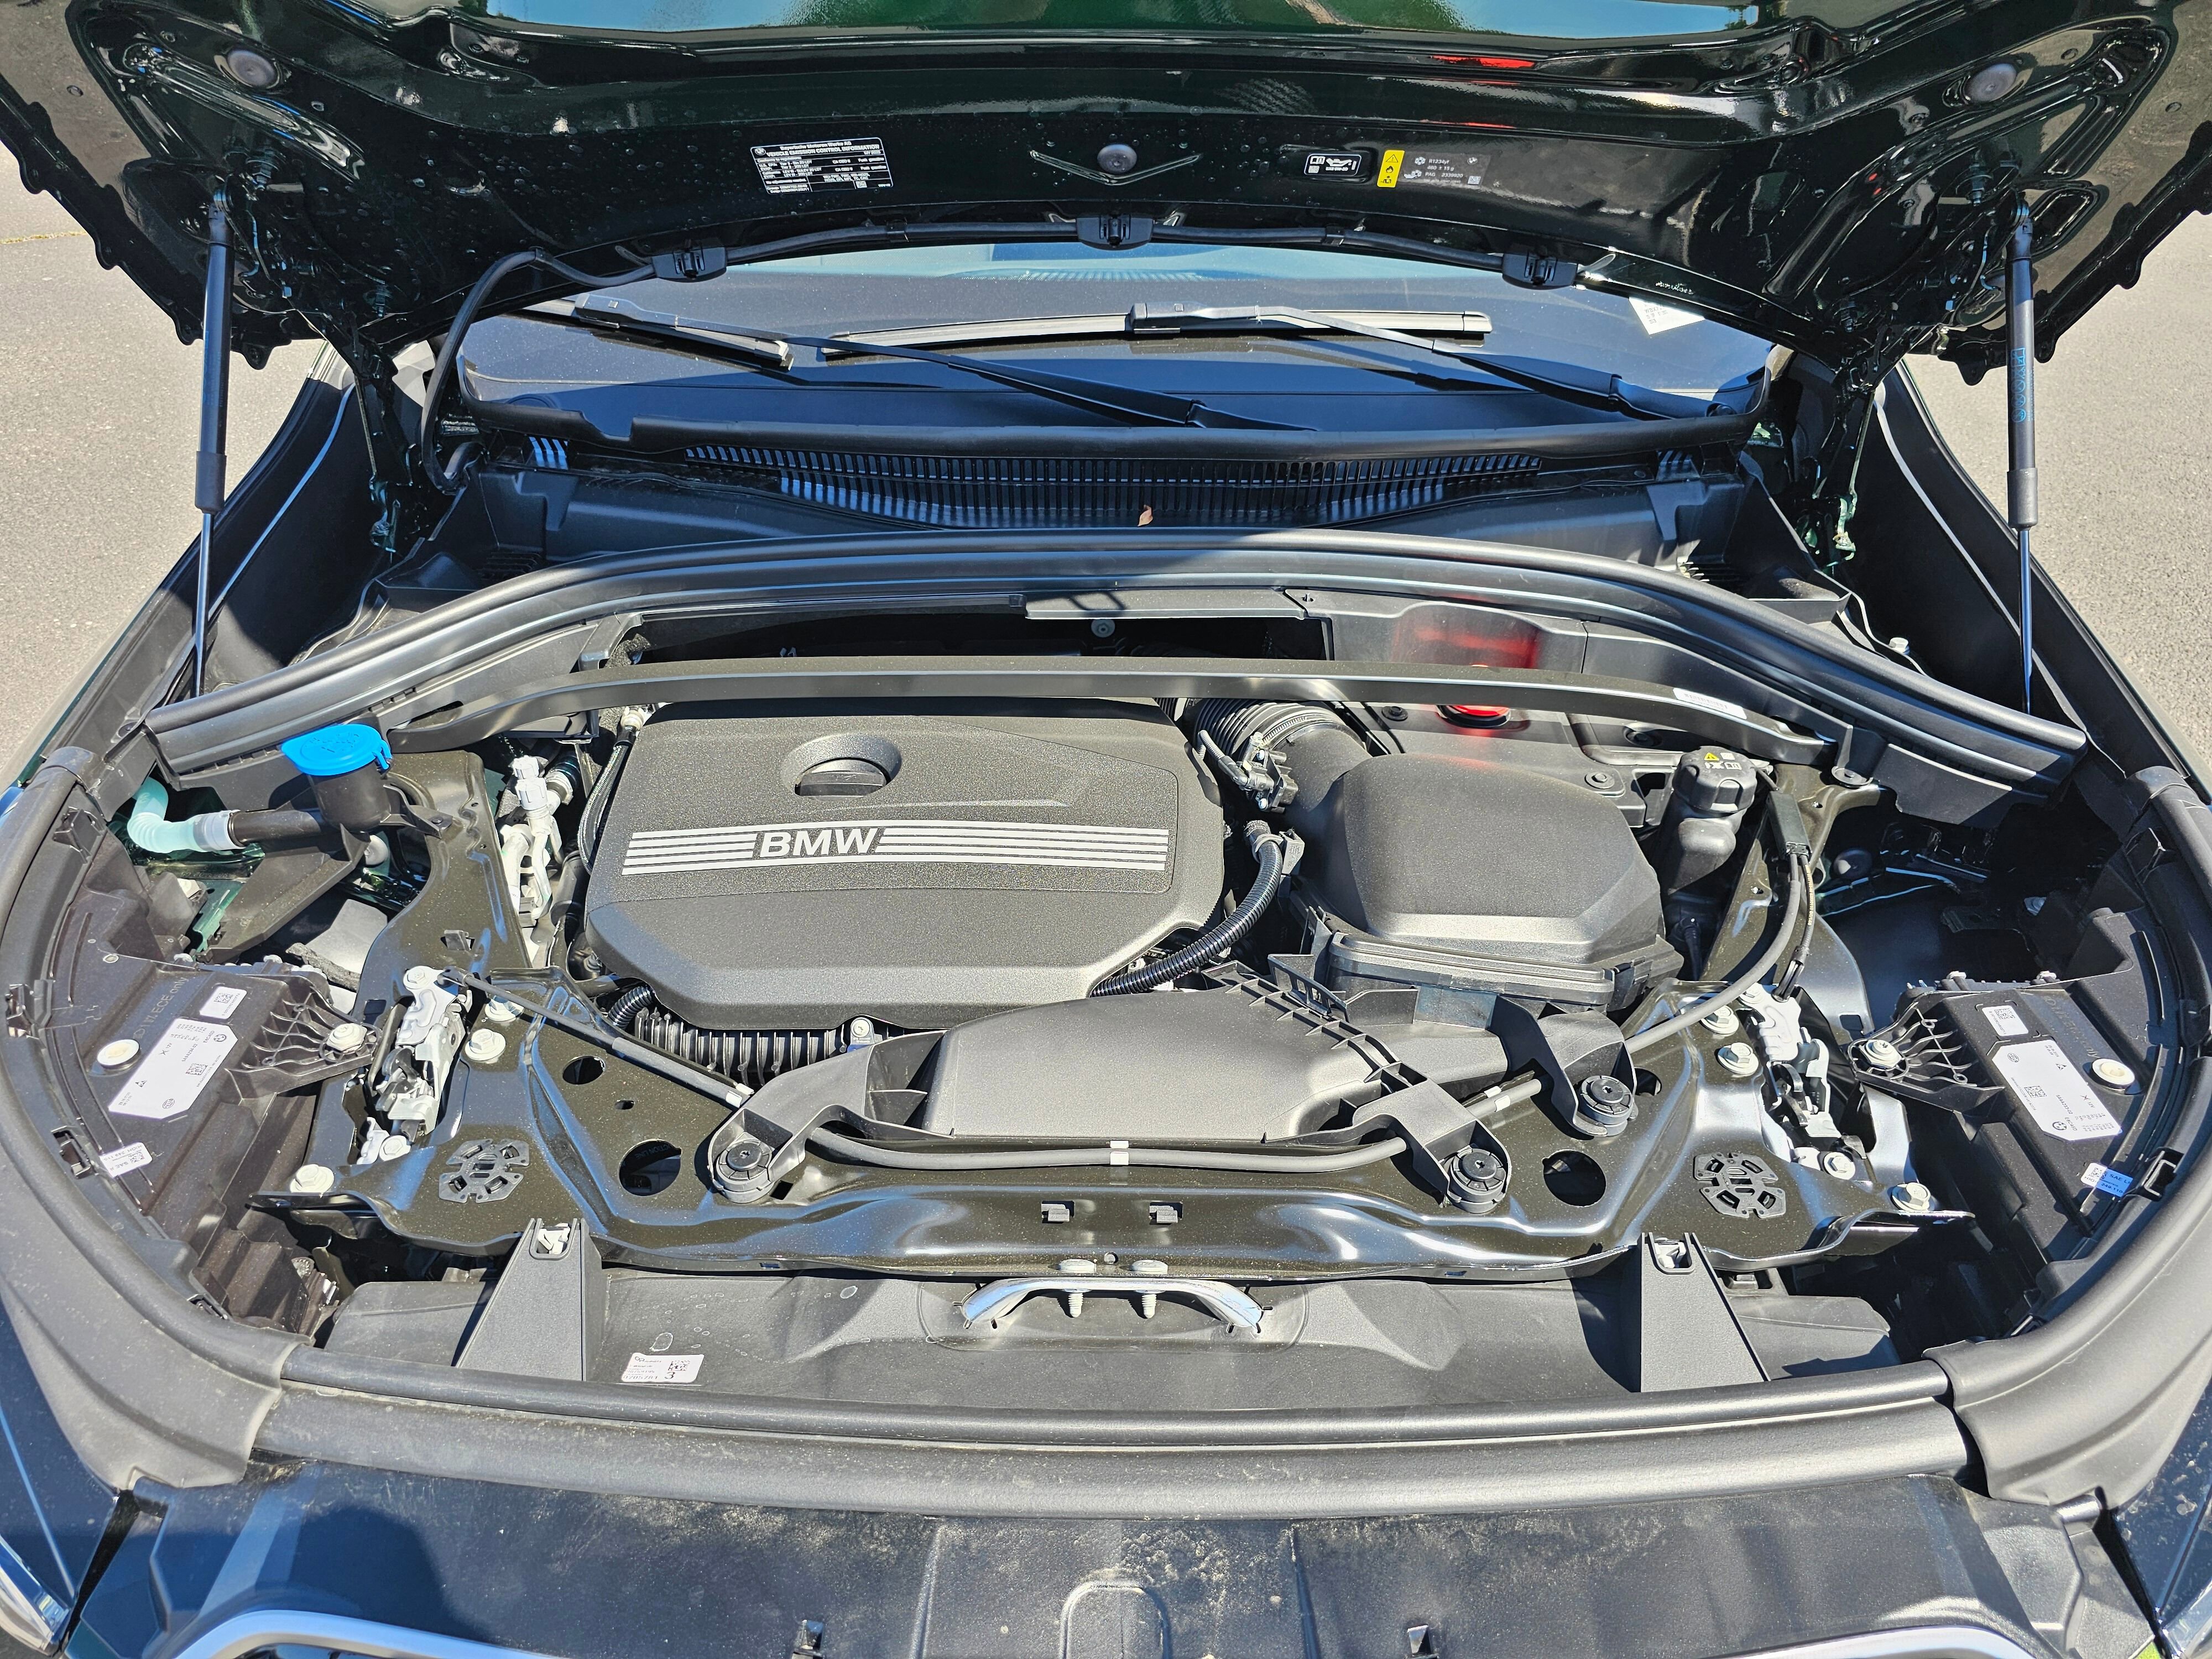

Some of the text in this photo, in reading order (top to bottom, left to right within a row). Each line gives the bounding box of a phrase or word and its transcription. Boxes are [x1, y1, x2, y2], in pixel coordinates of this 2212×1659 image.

[759, 827, 880, 859] BMW
[150, 994, 174, 1014] ECE
[169, 977, 189, 994] only
[2101, 1183, 2123, 1193] 249.110
